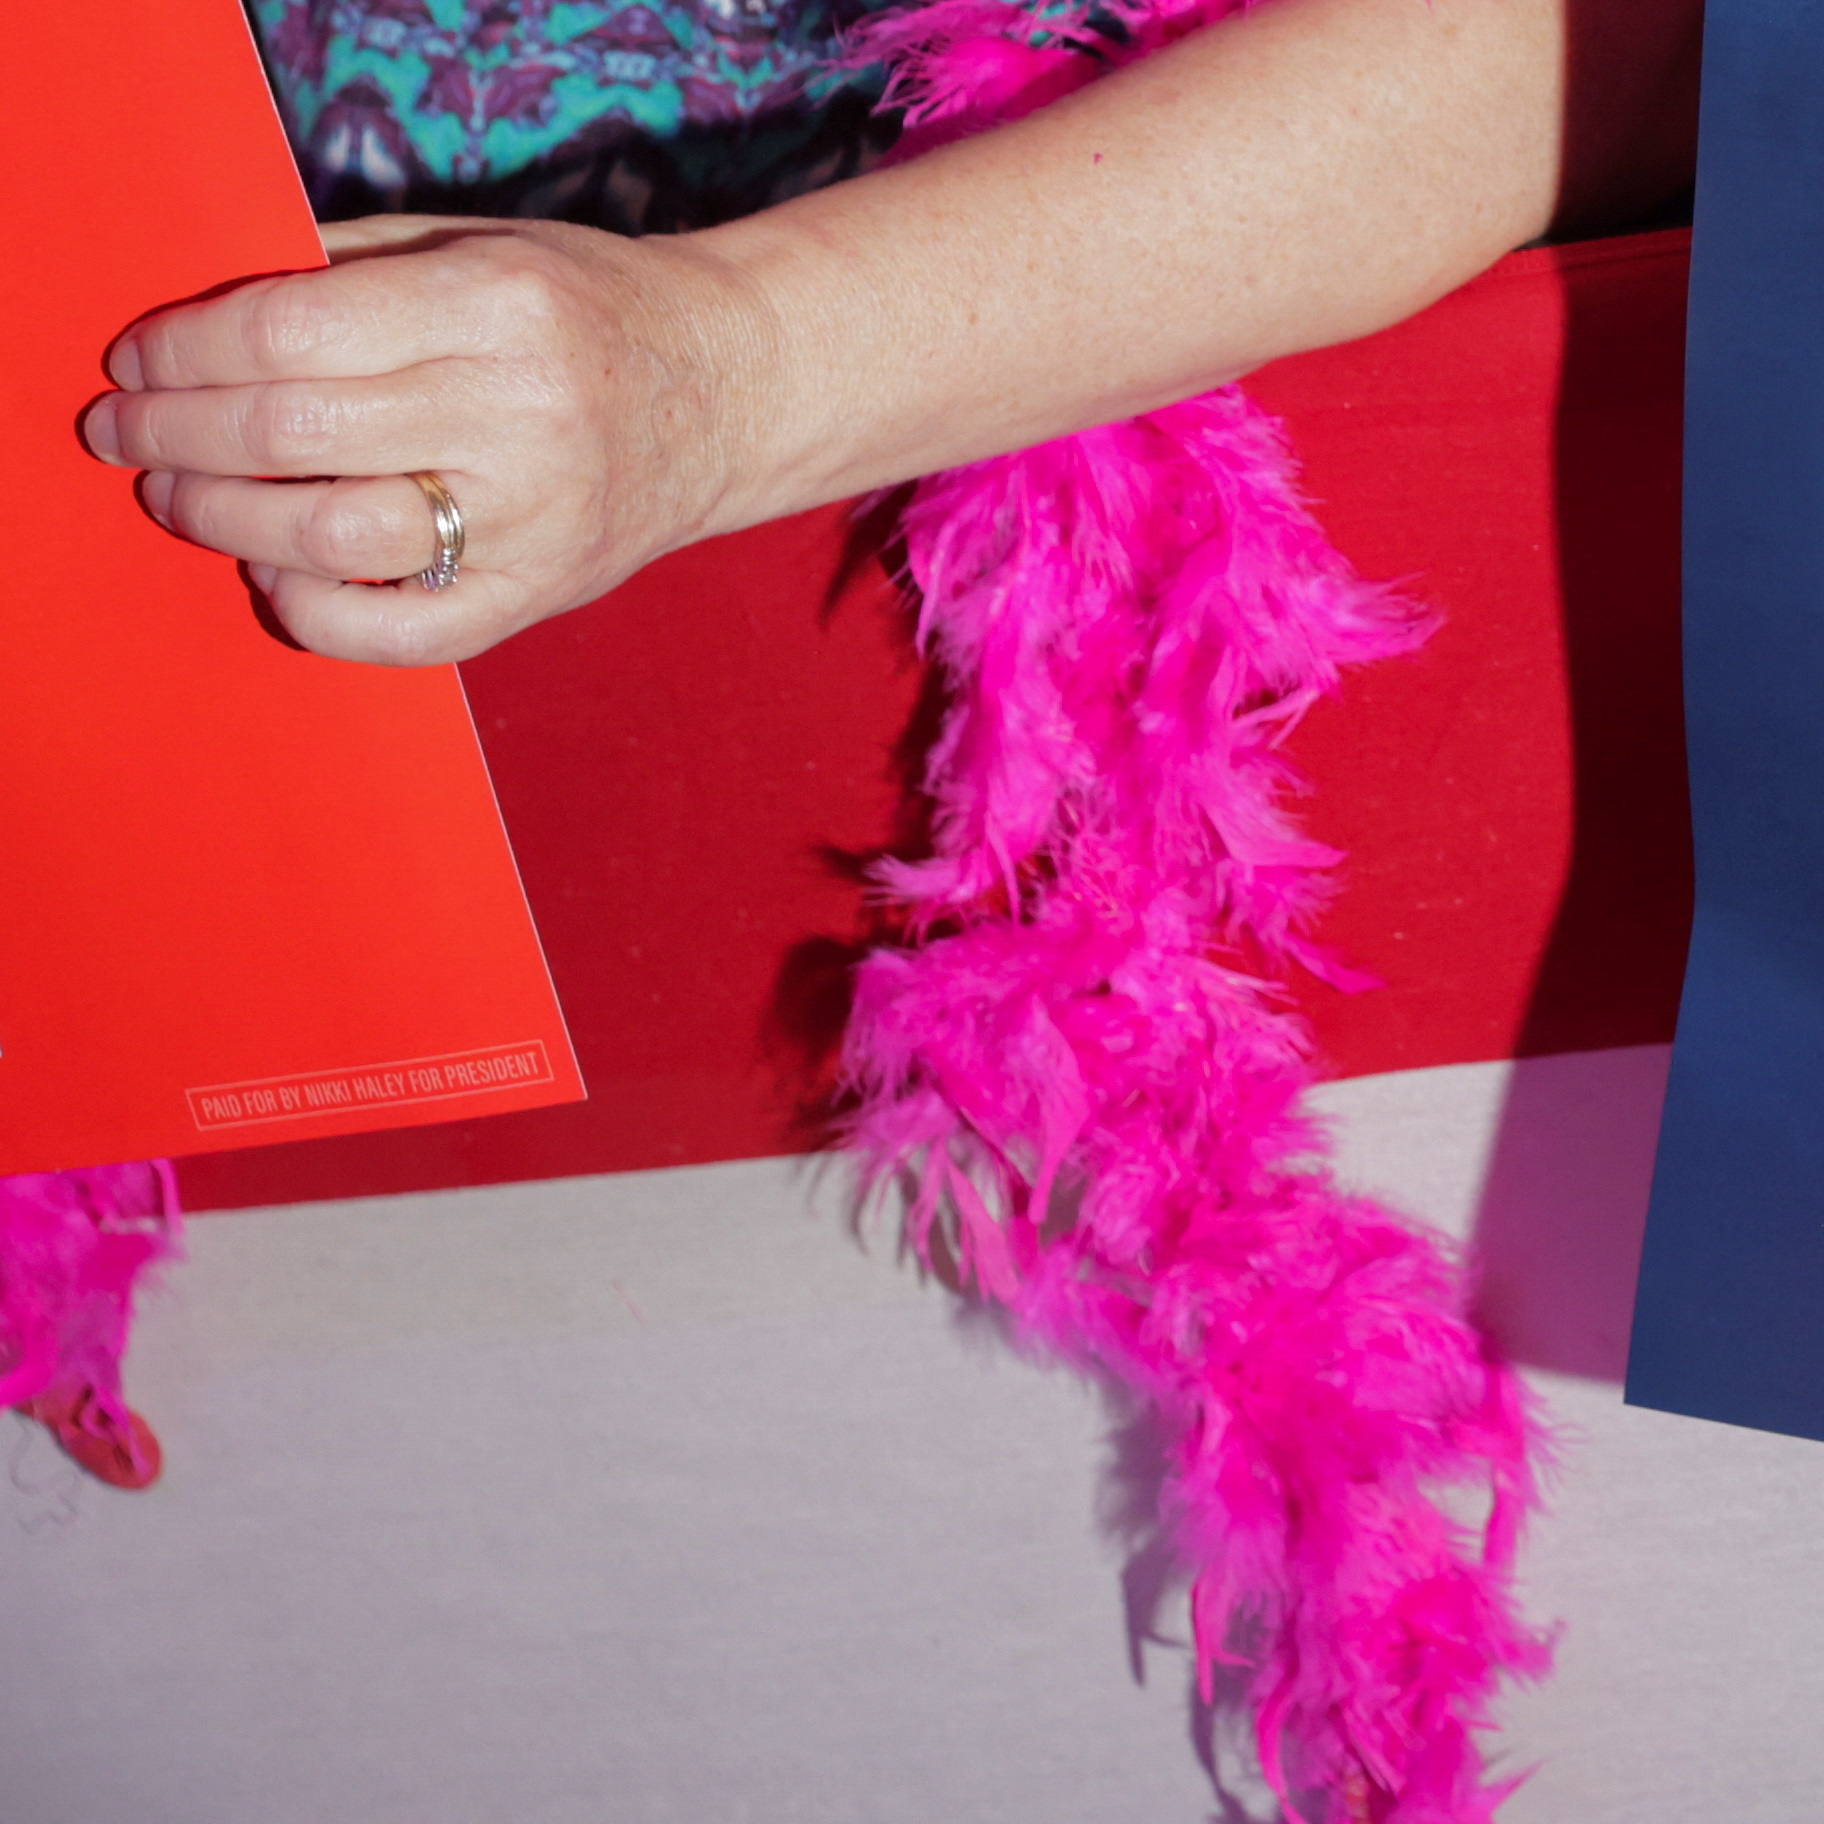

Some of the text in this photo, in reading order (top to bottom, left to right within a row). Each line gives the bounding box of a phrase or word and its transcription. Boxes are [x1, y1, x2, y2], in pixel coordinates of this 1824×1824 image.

[201, 1051, 541, 1121] PAID FOR BY NIKKI HALEY FOR PRESIDENT
